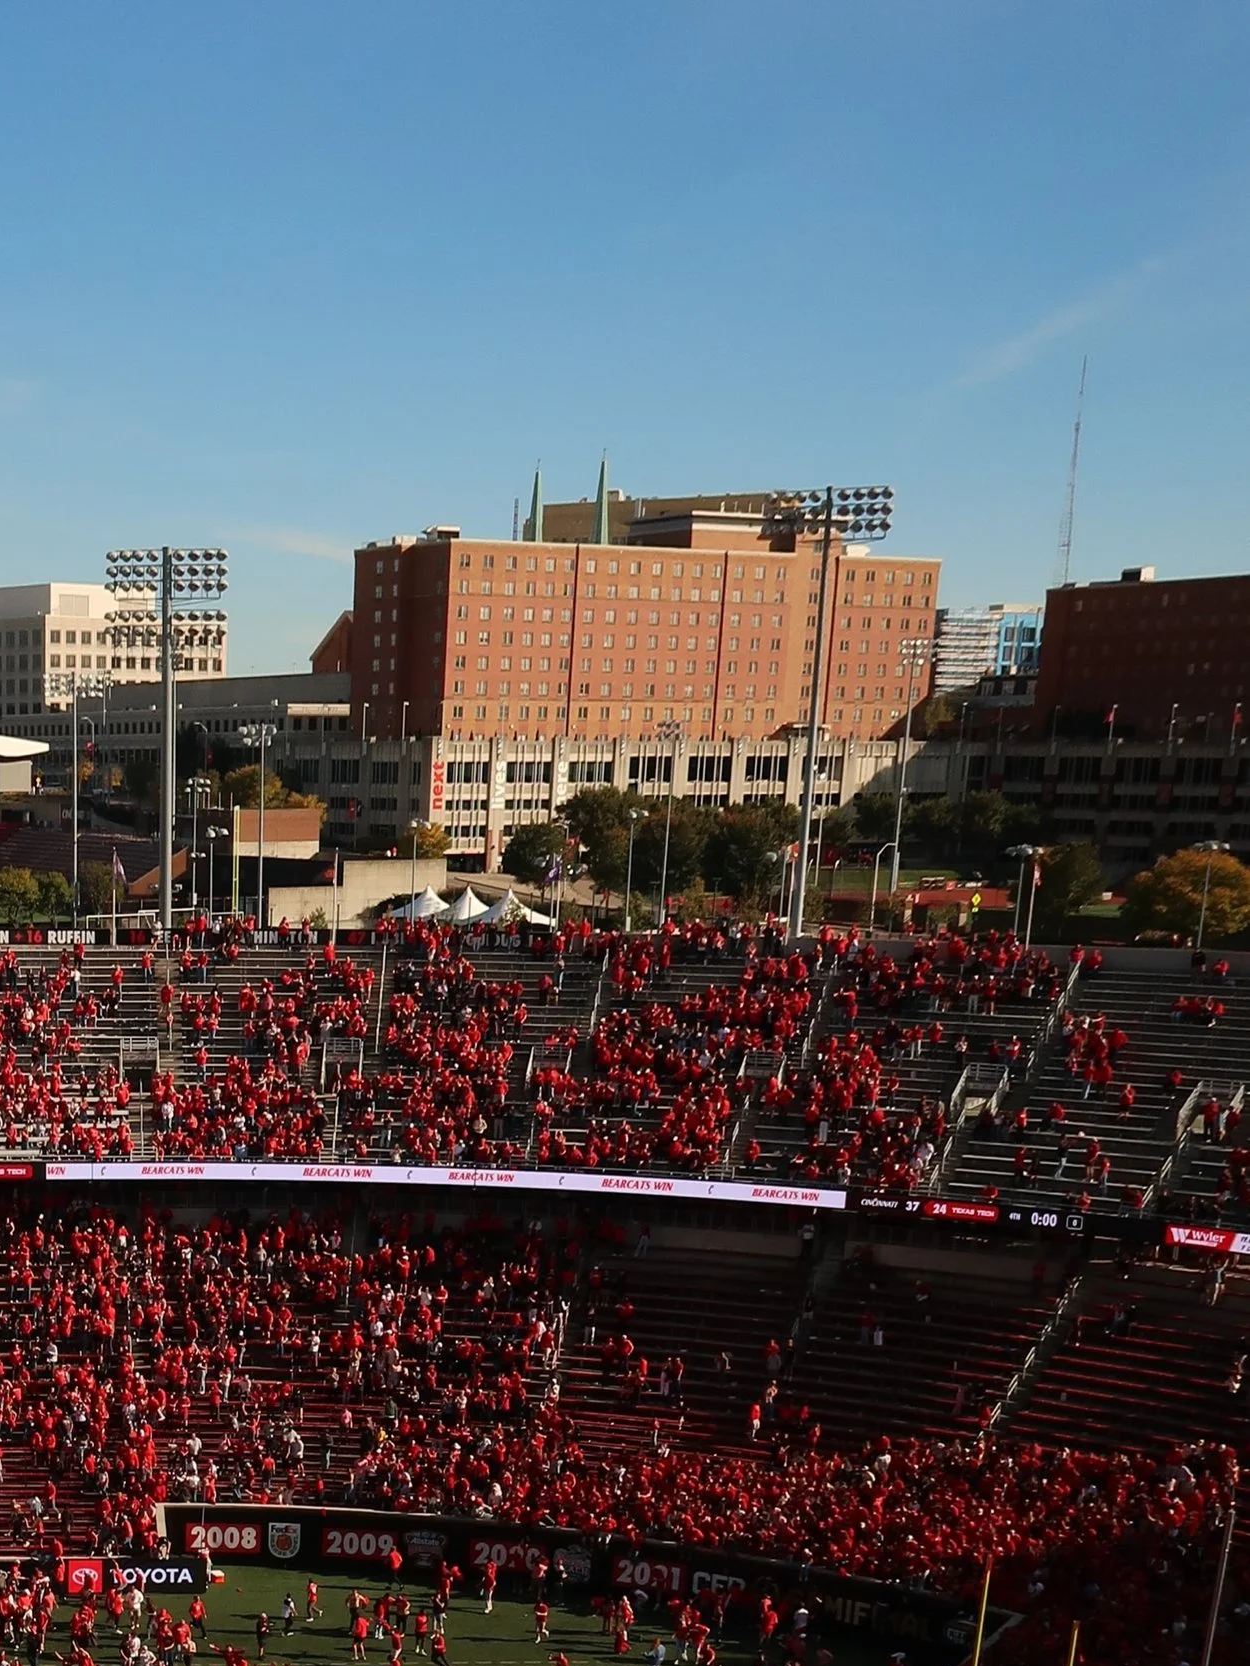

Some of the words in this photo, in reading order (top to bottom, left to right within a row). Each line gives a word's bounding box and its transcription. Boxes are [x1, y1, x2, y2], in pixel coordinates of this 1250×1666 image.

[432, 760, 445, 810] next
[490, 760, 507, 809] lives
[26, 930, 43, 944] 16
[48, 930, 96, 944] RUFFIN
[47, 1167, 66, 1176] WIN
[141, 1167, 185, 1176] BEARCATS
[187, 1167, 205, 1176] WIN
[302, 1168, 350, 1177] BEARCATS
[353, 1169, 373, 1178] WIN
[448, 1172, 494, 1182] BEARCATS
[497, 1173, 515, 1183] WIN
[601, 1179, 650, 1190] BEARCATS
[653, 1182, 673, 1191] WIN
[751, 1188, 798, 1200] BEARCATS
[801, 1192, 820, 1201] WIN
[860, 1198, 898, 1208] CINCINNATI
[905, 1201, 920, 1212] 37
[933, 1203, 947, 1214] 24
[952, 1207, 975, 1215] TEXAS
[977, 1209, 995, 1217] TECH
[1009, 1212, 1021, 1221] 4TH
[1031, 1212, 1057, 1227] 0:00
[1192, 1230, 1226, 1243] Wyler
[190, 1526, 257, 1550] 2008
[326, 1530, 393, 1556] 2009
